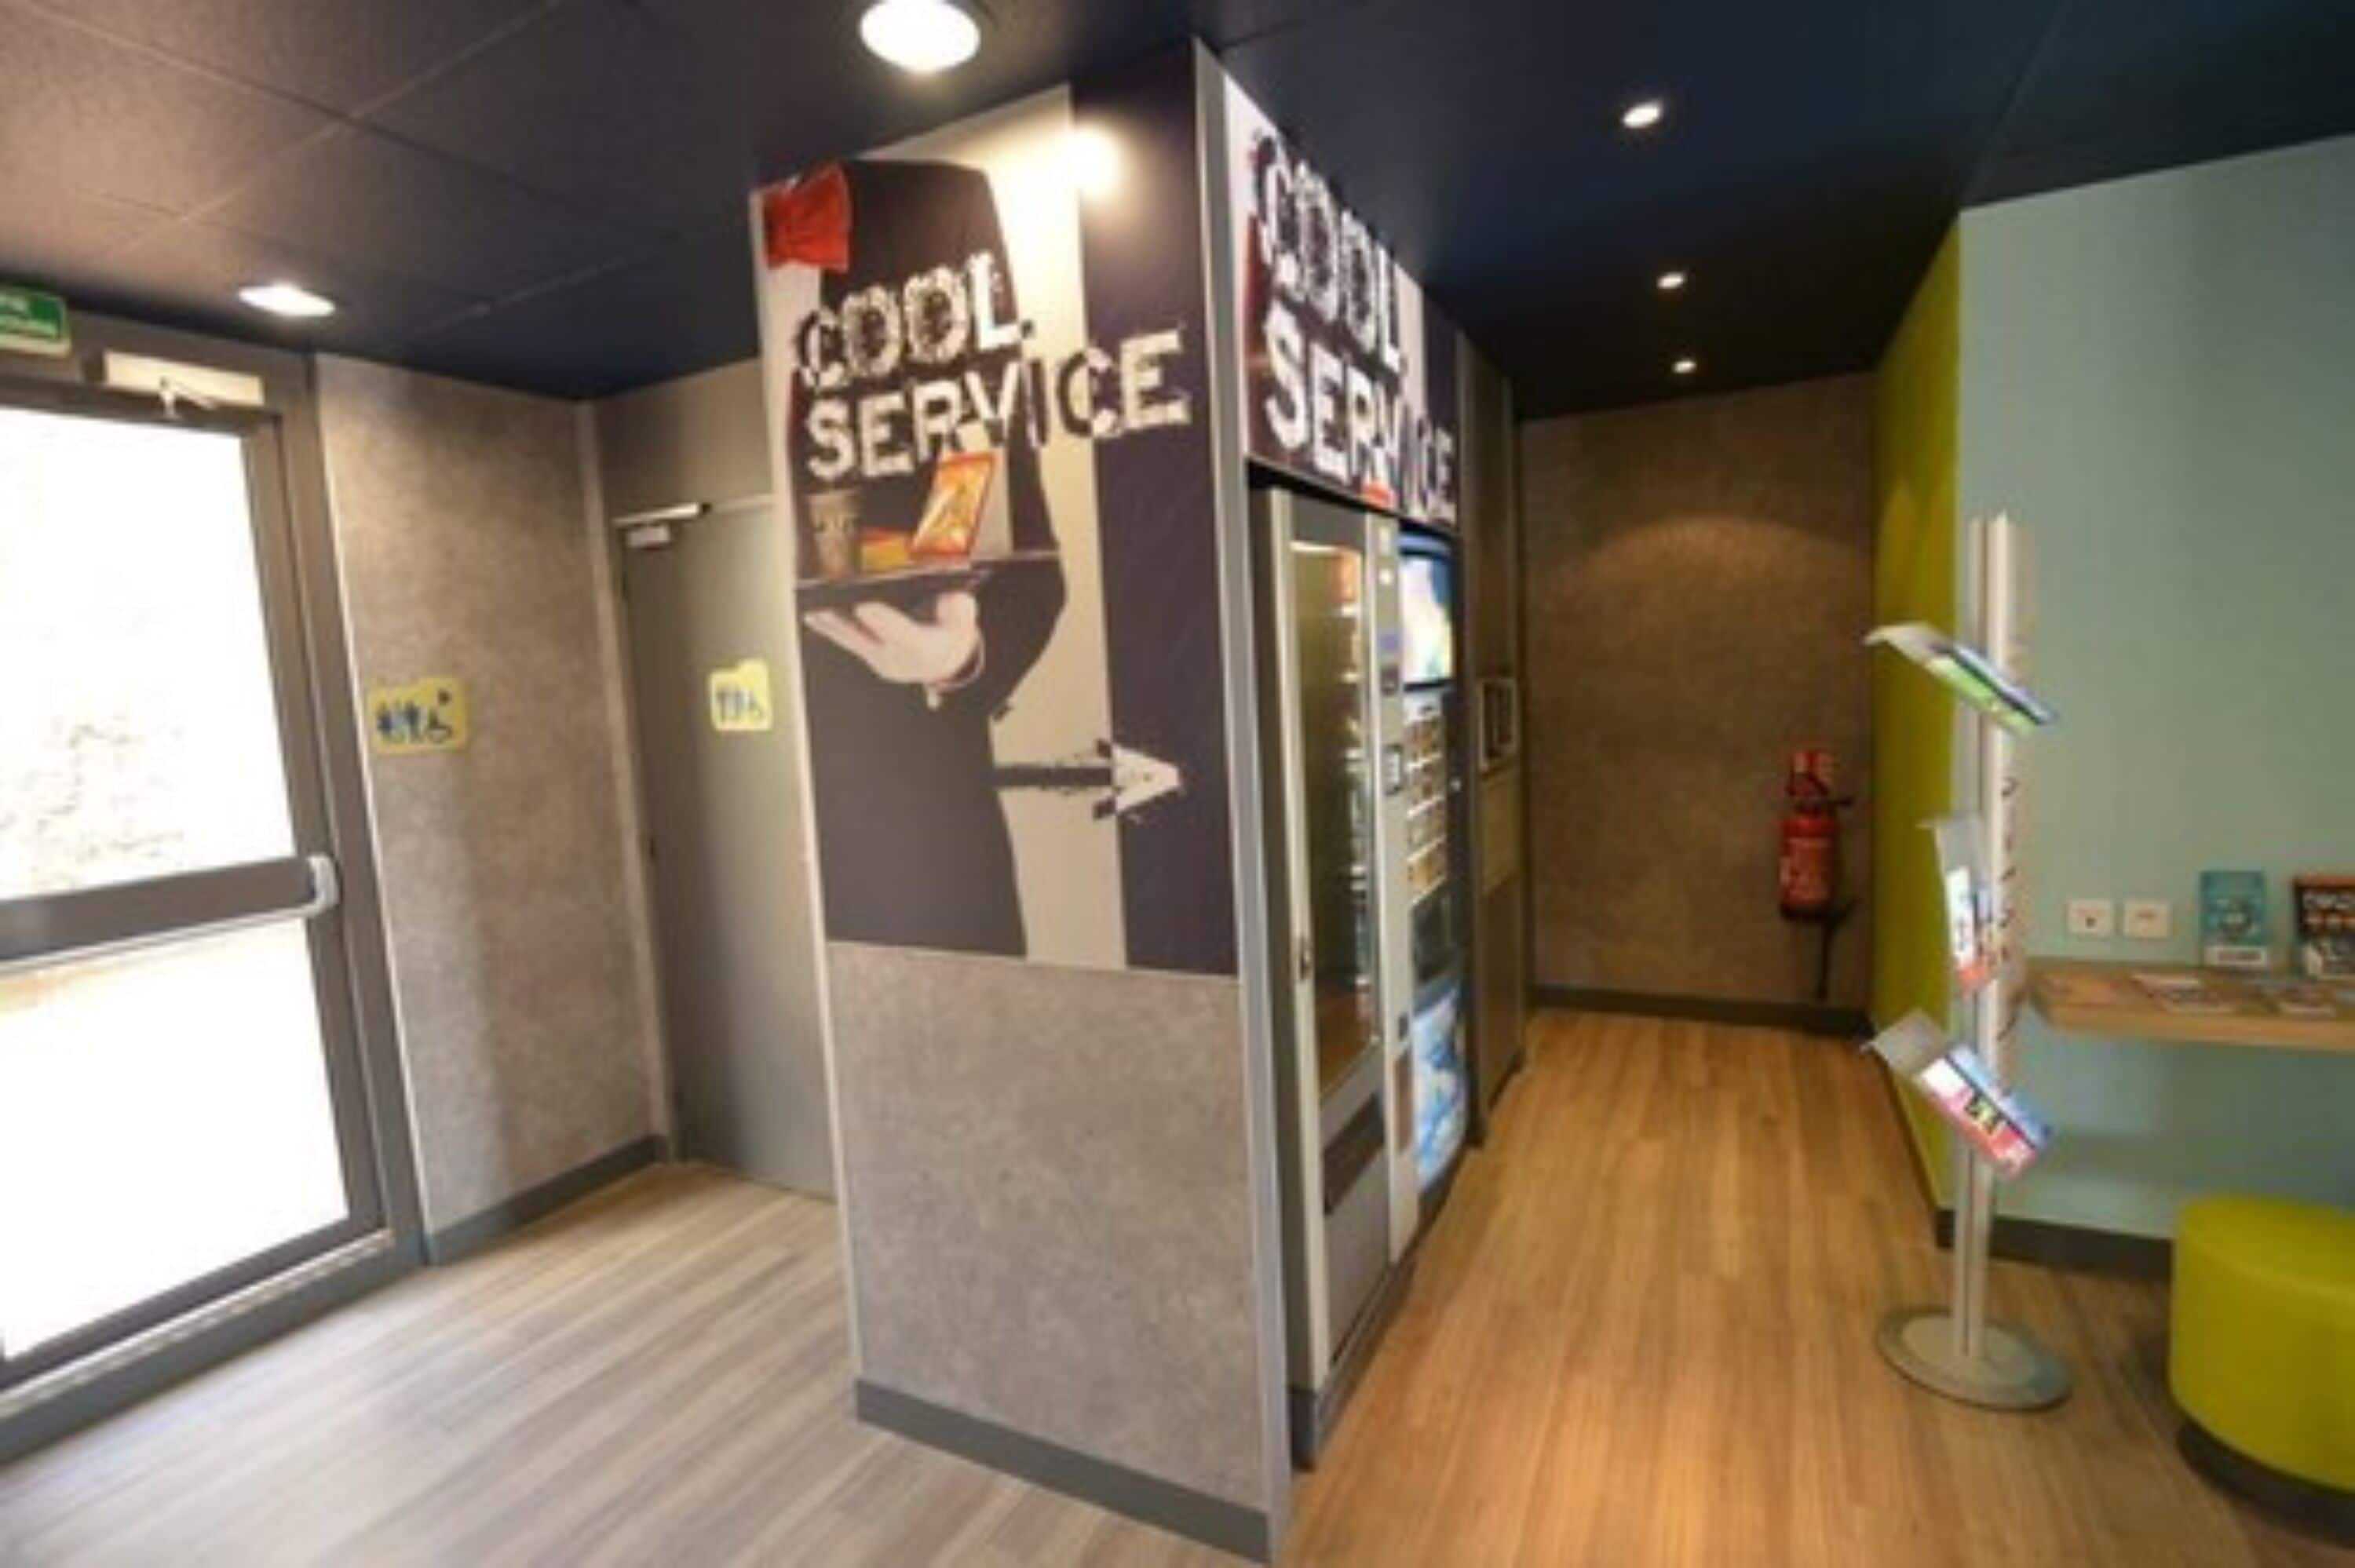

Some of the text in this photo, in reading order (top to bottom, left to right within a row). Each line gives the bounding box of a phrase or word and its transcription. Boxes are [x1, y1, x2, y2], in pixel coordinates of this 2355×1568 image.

[796, 251, 1035, 388] COOL
[1254, 133, 1404, 375] COOL
[807, 328, 1192, 480] SERVICE
[1264, 298, 1457, 524] SERVICE
